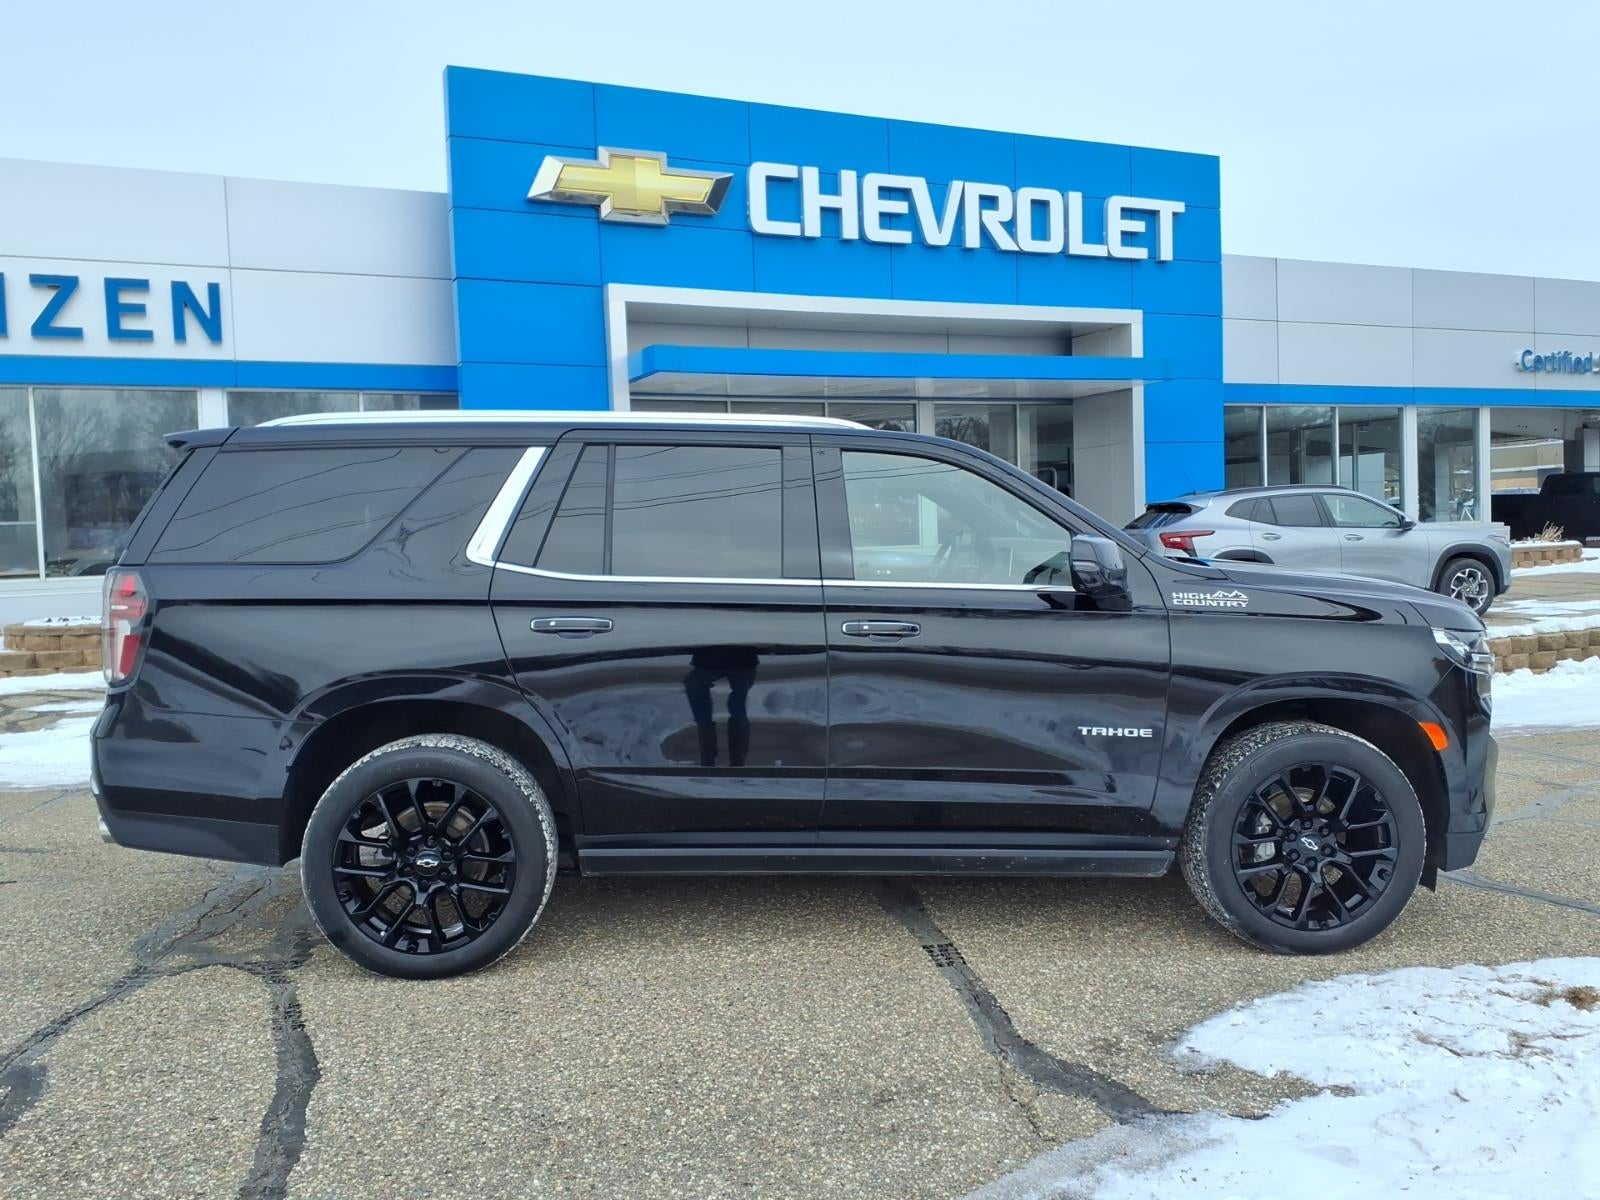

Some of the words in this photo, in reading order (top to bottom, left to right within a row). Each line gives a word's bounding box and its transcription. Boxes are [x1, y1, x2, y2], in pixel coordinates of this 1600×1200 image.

[748, 161, 1186, 263] CHEVROLET
[0, 272, 223, 346] ZEN
[1520, 349, 1593, 374] Certified
[1172, 599, 1249, 607] COUNTRY
[1077, 726, 1153, 738] TAHOE
